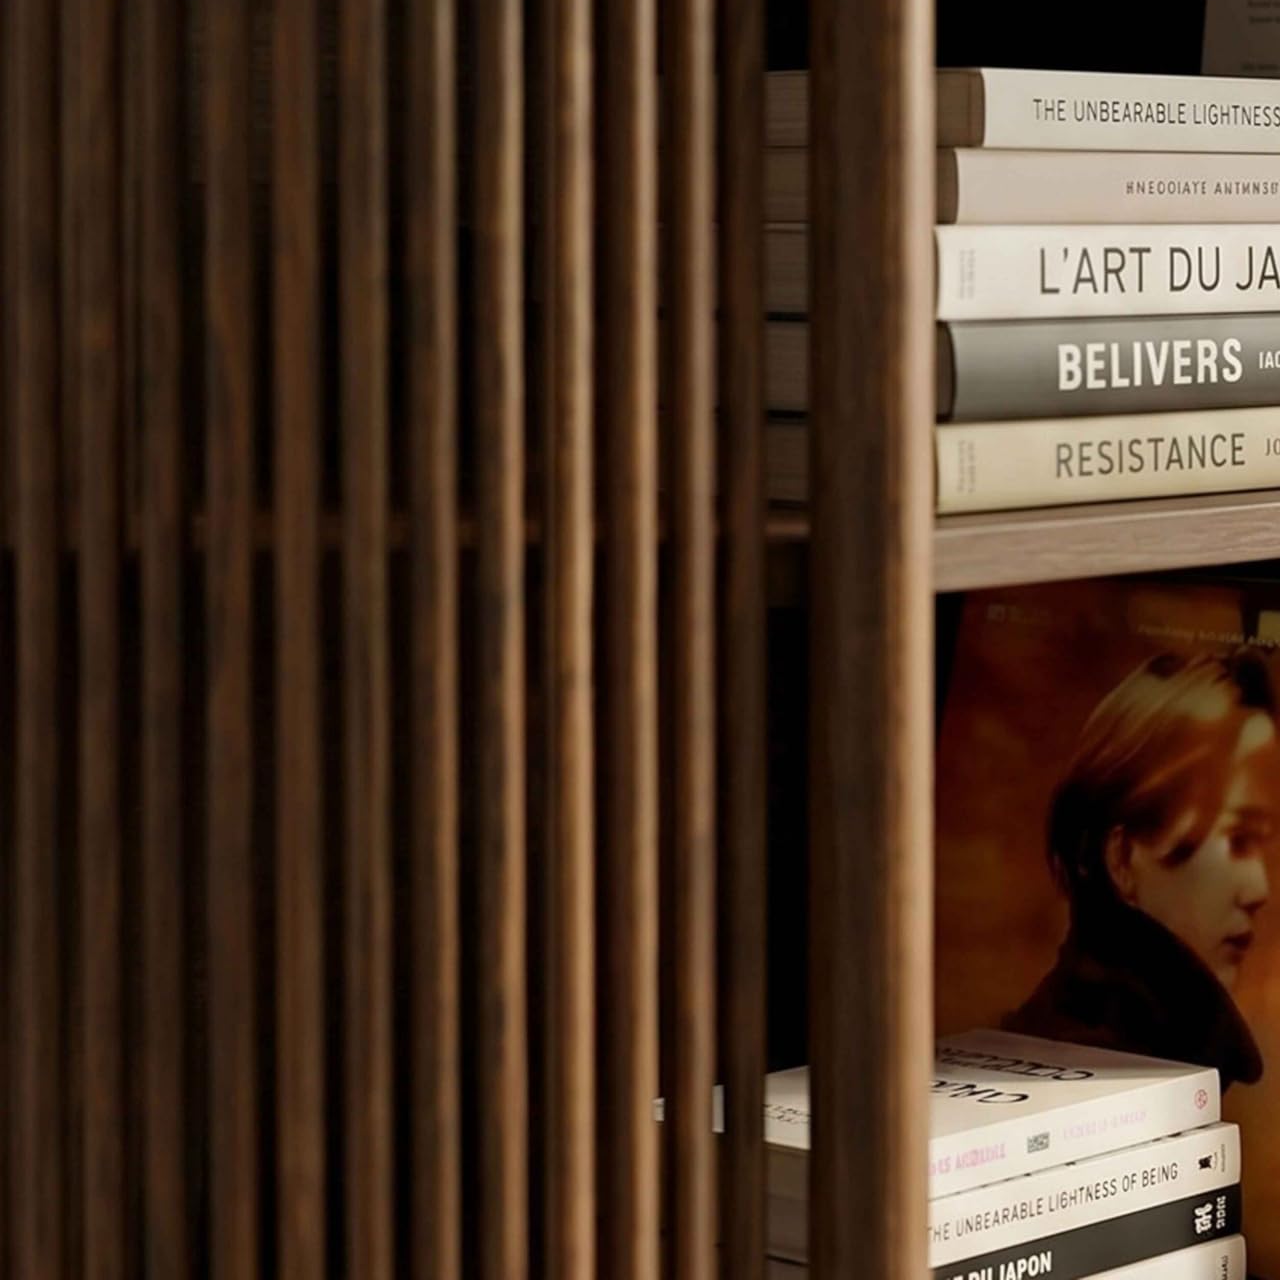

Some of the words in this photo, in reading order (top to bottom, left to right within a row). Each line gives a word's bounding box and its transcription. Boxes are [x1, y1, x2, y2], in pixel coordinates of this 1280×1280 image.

[1032, 98, 1066, 121] THE
[1074, 100, 1187, 124] UNBEARABLE
[1039, 246, 1151, 295] L'ART
[1169, 245, 1222, 293] DU
[1057, 337, 1244, 391] BELIVERS
[1055, 432, 1246, 478] RESISTANCE
[956, 1197, 1043, 1237] UNBEARABLE
[1048, 1178, 1117, 1212] LIGHTNESS
[1122, 1173, 1137, 1192] OF
[1142, 1162, 1178, 1188] BEING
[1000, 1251, 1052, 1280] JAPON
